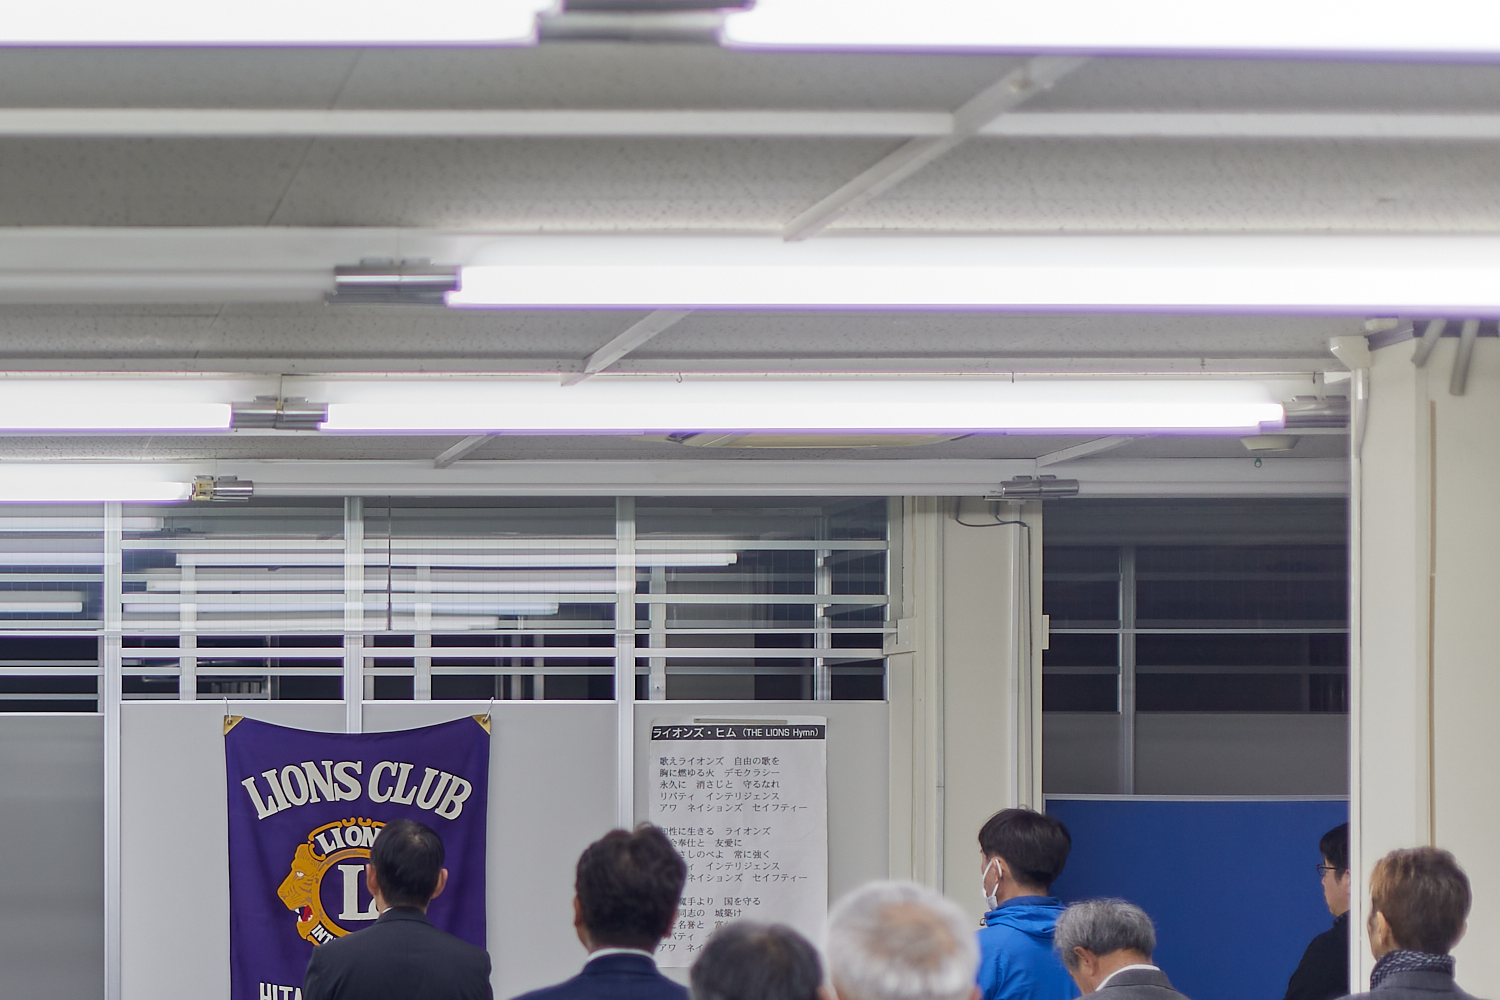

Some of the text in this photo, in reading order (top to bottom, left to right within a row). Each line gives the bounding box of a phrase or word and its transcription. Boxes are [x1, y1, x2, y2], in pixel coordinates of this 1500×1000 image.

[653, 727, 737, 739] ライオンズ・ヒム
[765, 728, 790, 737] LIONS
[659, 756, 780, 766] 歌えライオンズ 自由の歌を
[724, 768, 780, 778] デモクラシー
[659, 780, 780, 789] 永久に 消さじと 守るなれ
[241, 760, 473, 821] LIONS CLUB
[705, 792, 780, 801] インテリジェンス
[659, 803, 808, 813] アワ ネイションズ セイフティー
[725, 826, 771, 836] ライオンズ
[314, 825, 382, 854] LION
[670, 838, 742, 848] 会奉仕と 友愛に
[680, 849, 770, 859] さしのべよ 常に強く
[705, 862, 780, 871] インテリジェンス
[687, 873, 808, 883] ネイションズ セイフティー
[337, 864, 380, 920] L
[724, 896, 761, 906] 国を守る
[678, 908, 706, 918] 同志の
[311, 924, 336, 944] INT
[659, 943, 676, 953] アワ
